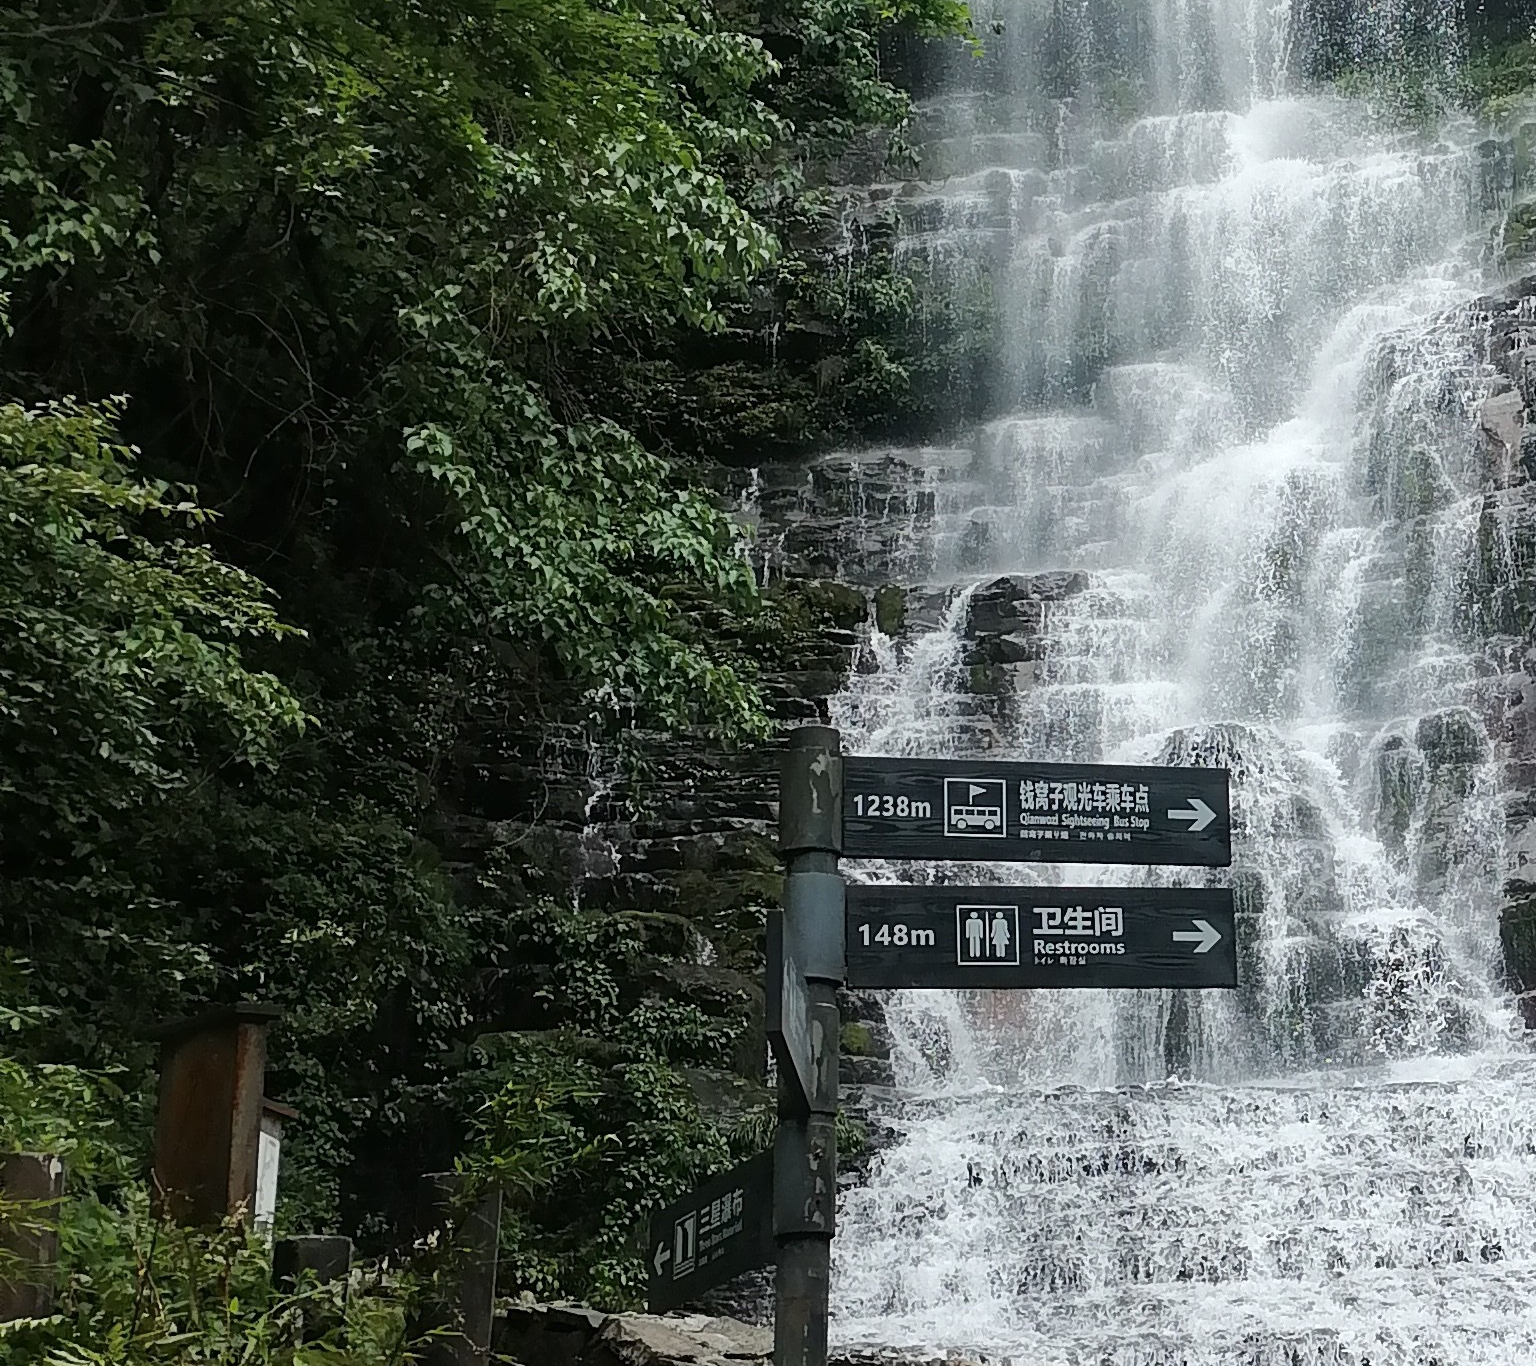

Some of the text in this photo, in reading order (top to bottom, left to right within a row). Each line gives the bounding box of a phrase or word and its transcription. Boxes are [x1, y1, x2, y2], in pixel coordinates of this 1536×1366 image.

[853, 794, 931, 818] 1238m
[1061, 814, 1110, 830] Sightseeing
[1113, 815, 1130, 827] Bus
[1130, 816, 1150, 832] Stop
[1032, 906, 1124, 937] 卫生间
[858, 923, 935, 946] 148m
[1033, 939, 1126, 955] Restrooms
